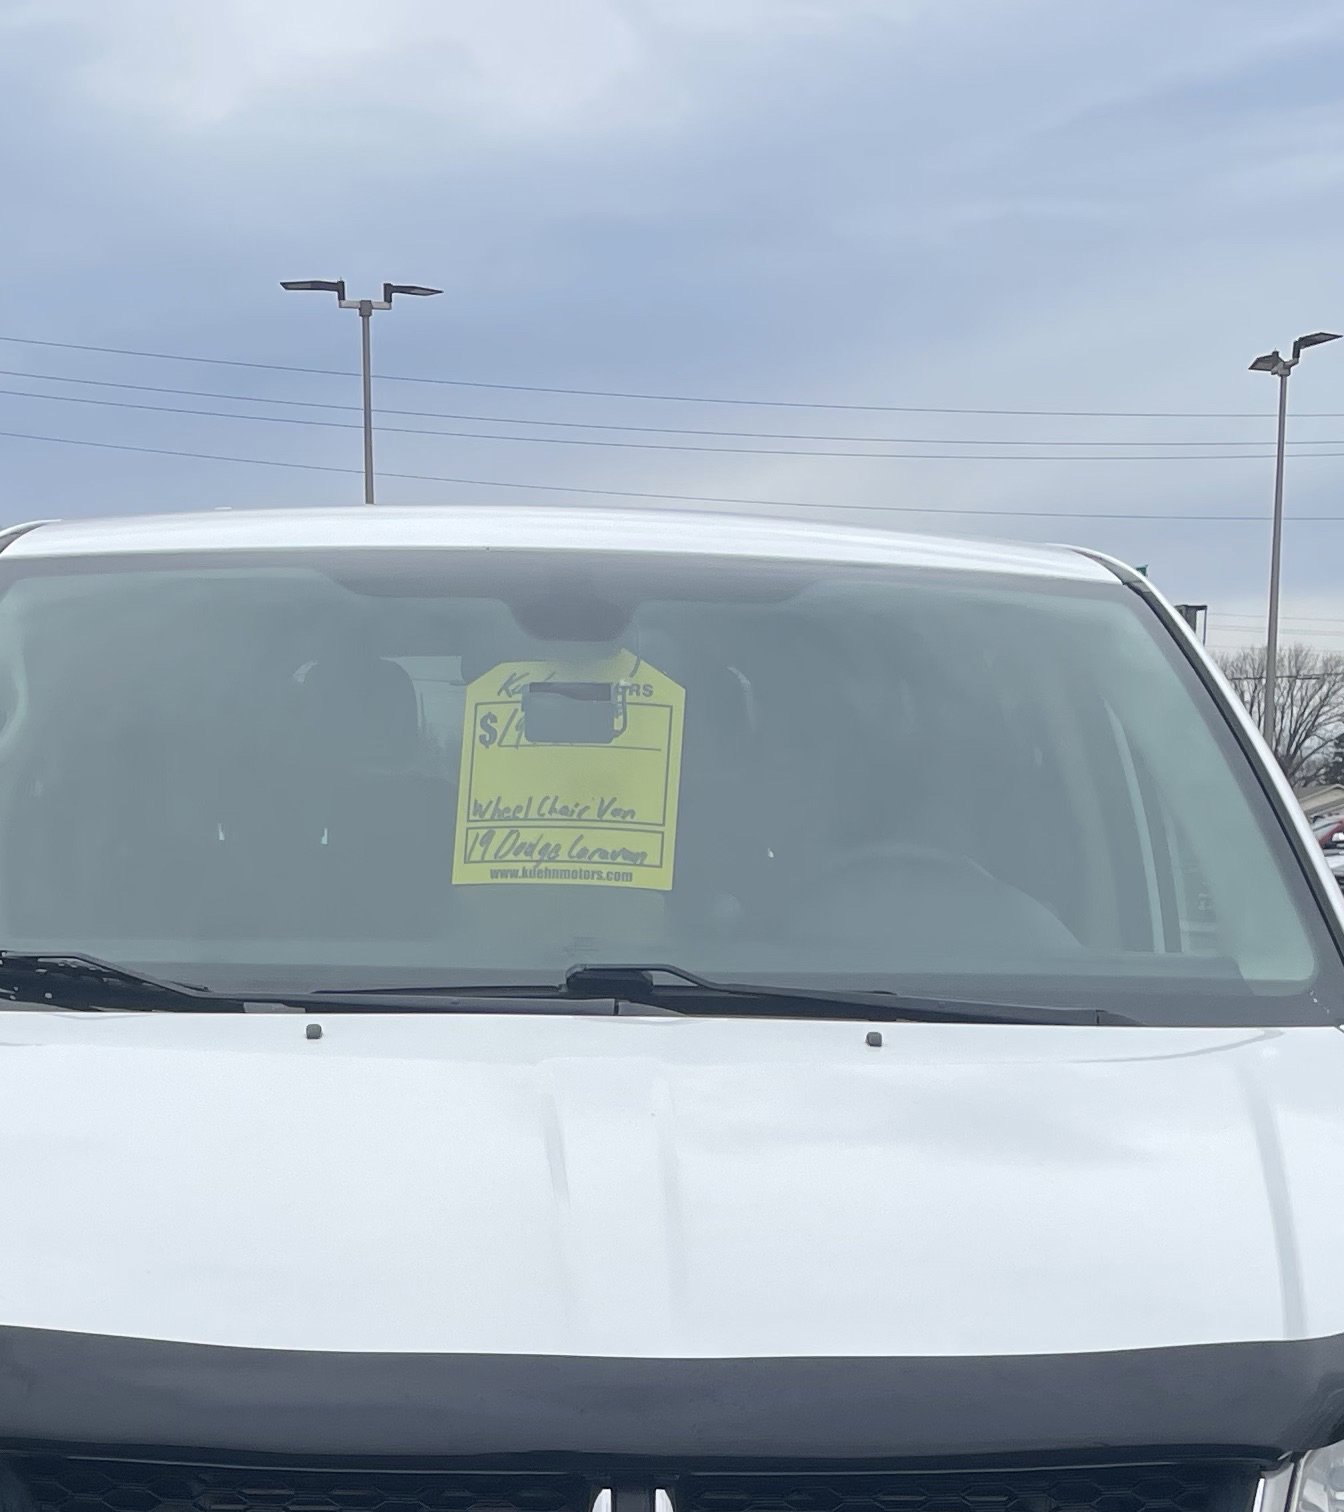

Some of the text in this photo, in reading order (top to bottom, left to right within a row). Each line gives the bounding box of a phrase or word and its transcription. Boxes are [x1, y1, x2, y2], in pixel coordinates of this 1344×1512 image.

[472, 795, 636, 820] Wheel Chair Van
[494, 829, 561, 868] Dodge
